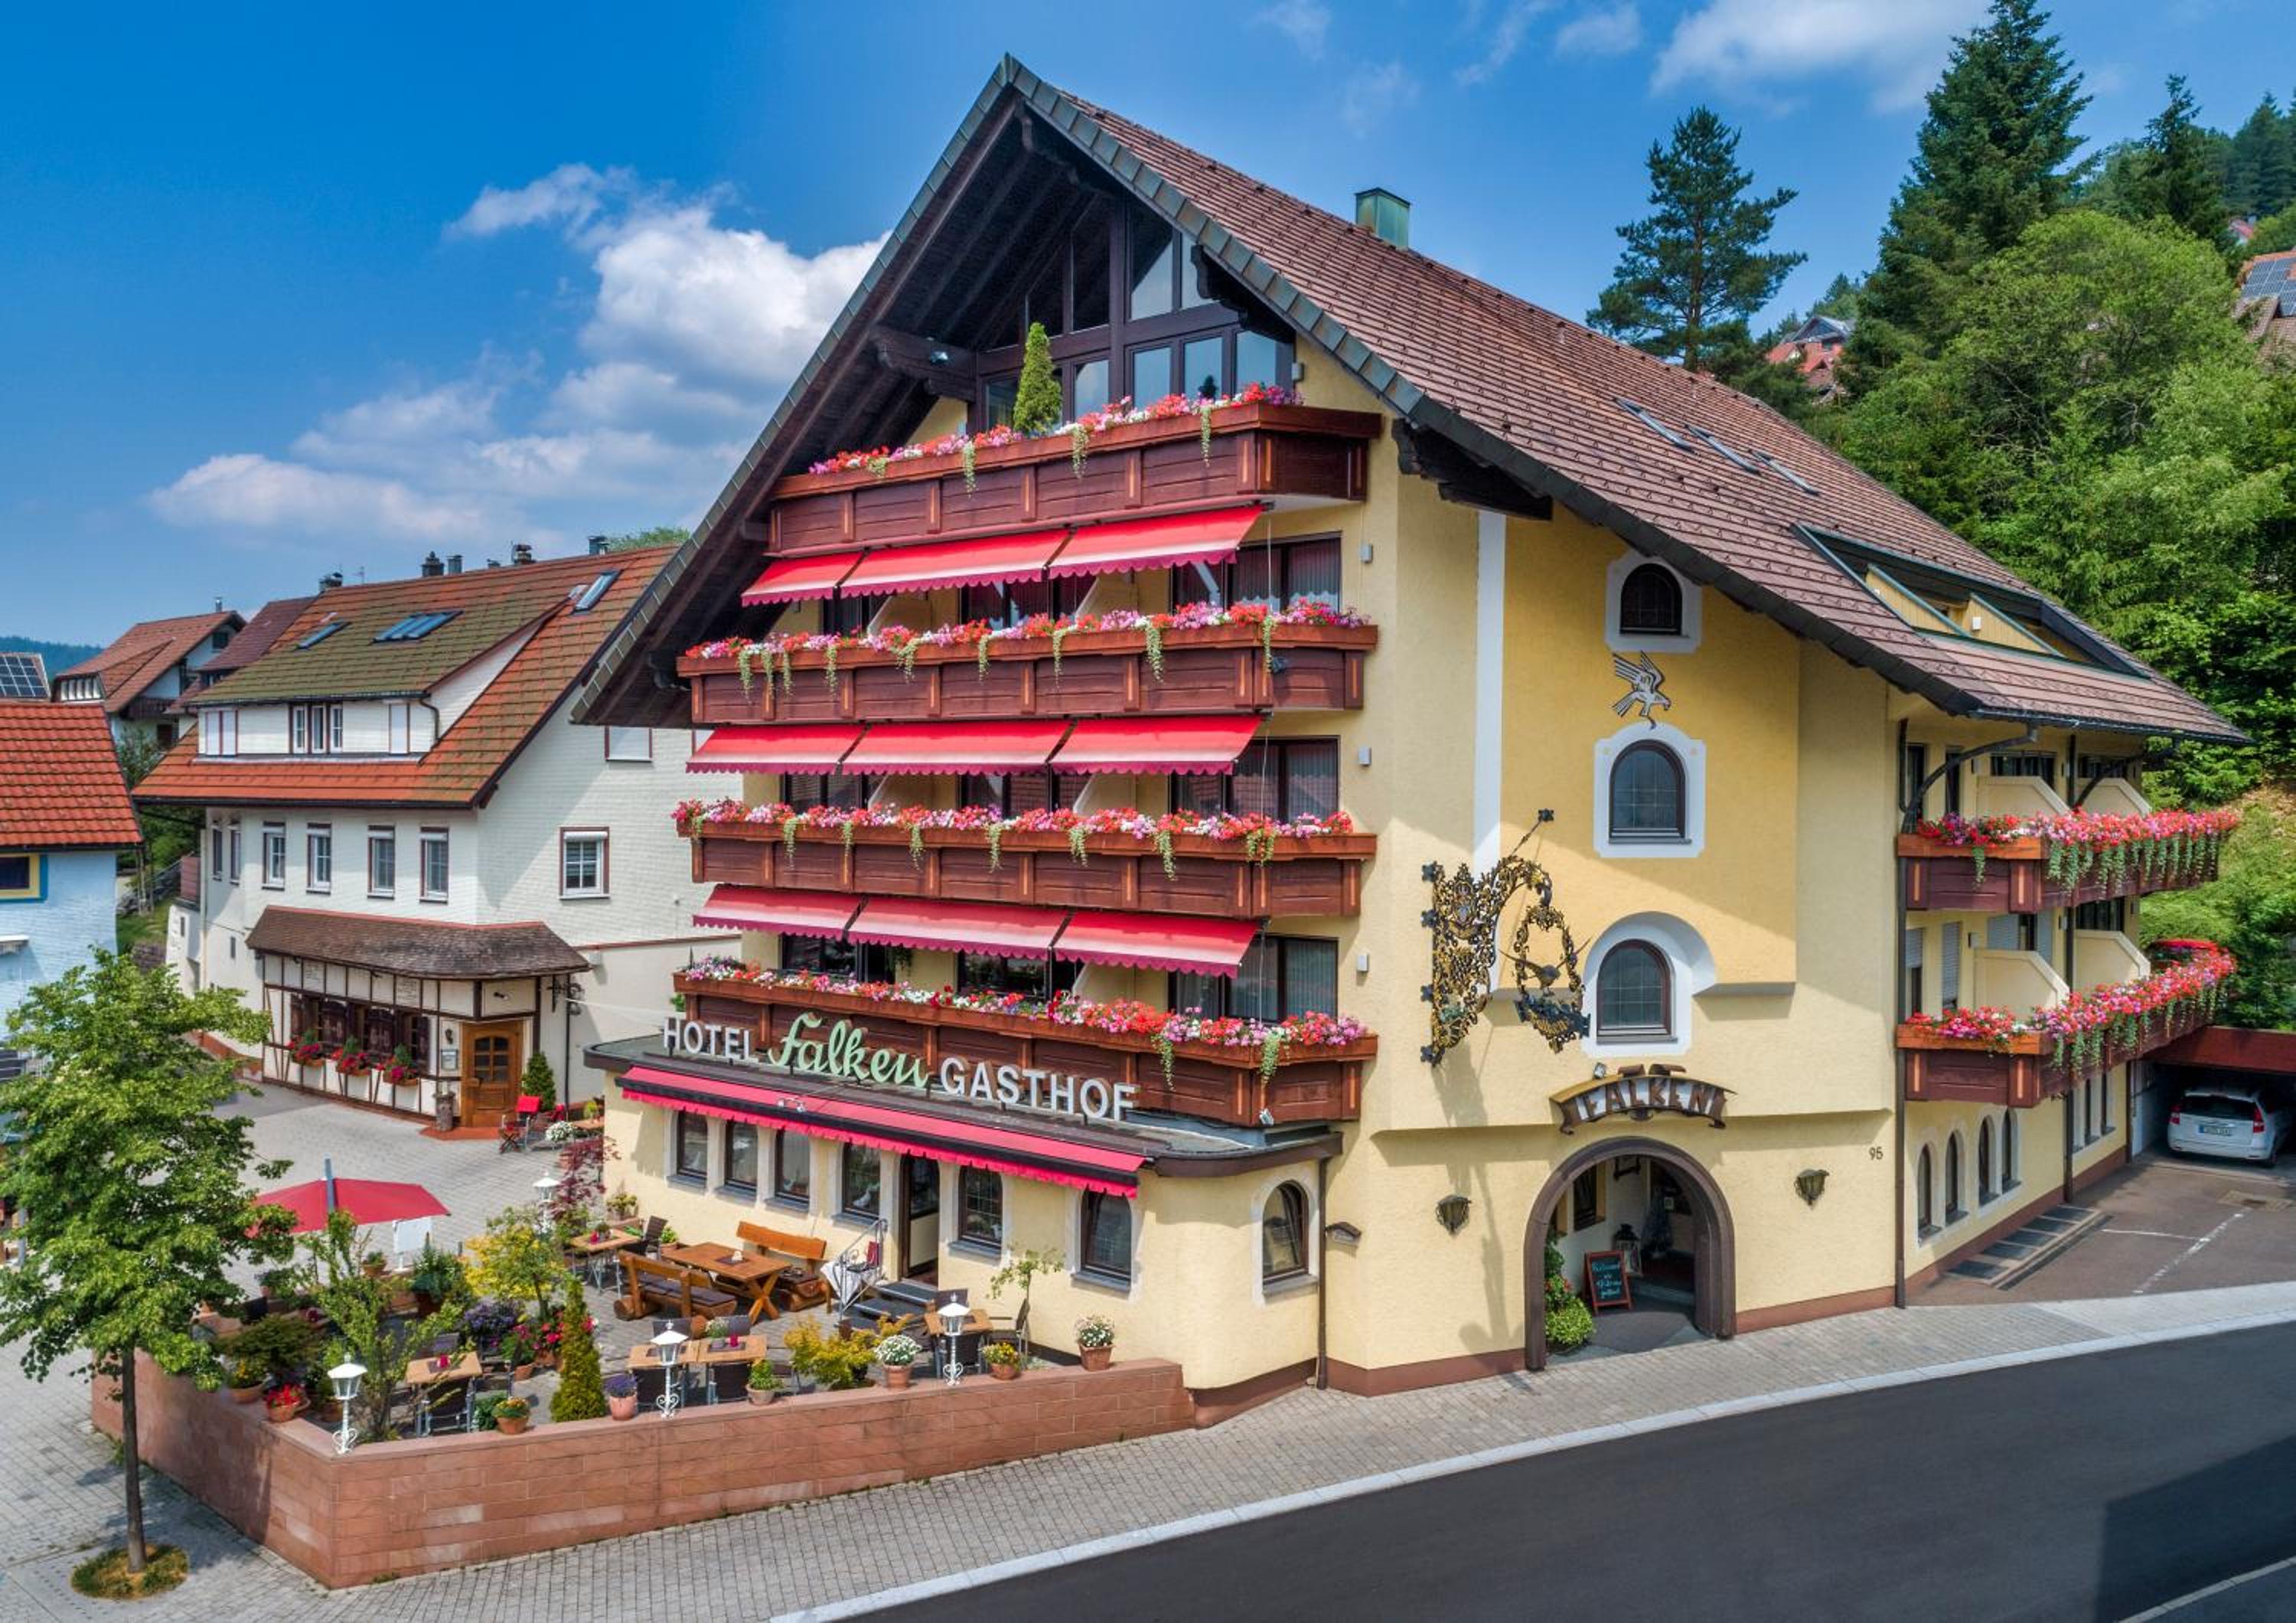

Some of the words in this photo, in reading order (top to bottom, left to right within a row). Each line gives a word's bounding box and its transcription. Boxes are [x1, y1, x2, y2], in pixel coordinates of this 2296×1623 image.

[664, 1017, 759, 1063] HOTEL
[768, 1011, 930, 1088] Falken
[941, 1056, 1137, 1121] GASTHOF
[1583, 1077, 1713, 1121] FALKEN
